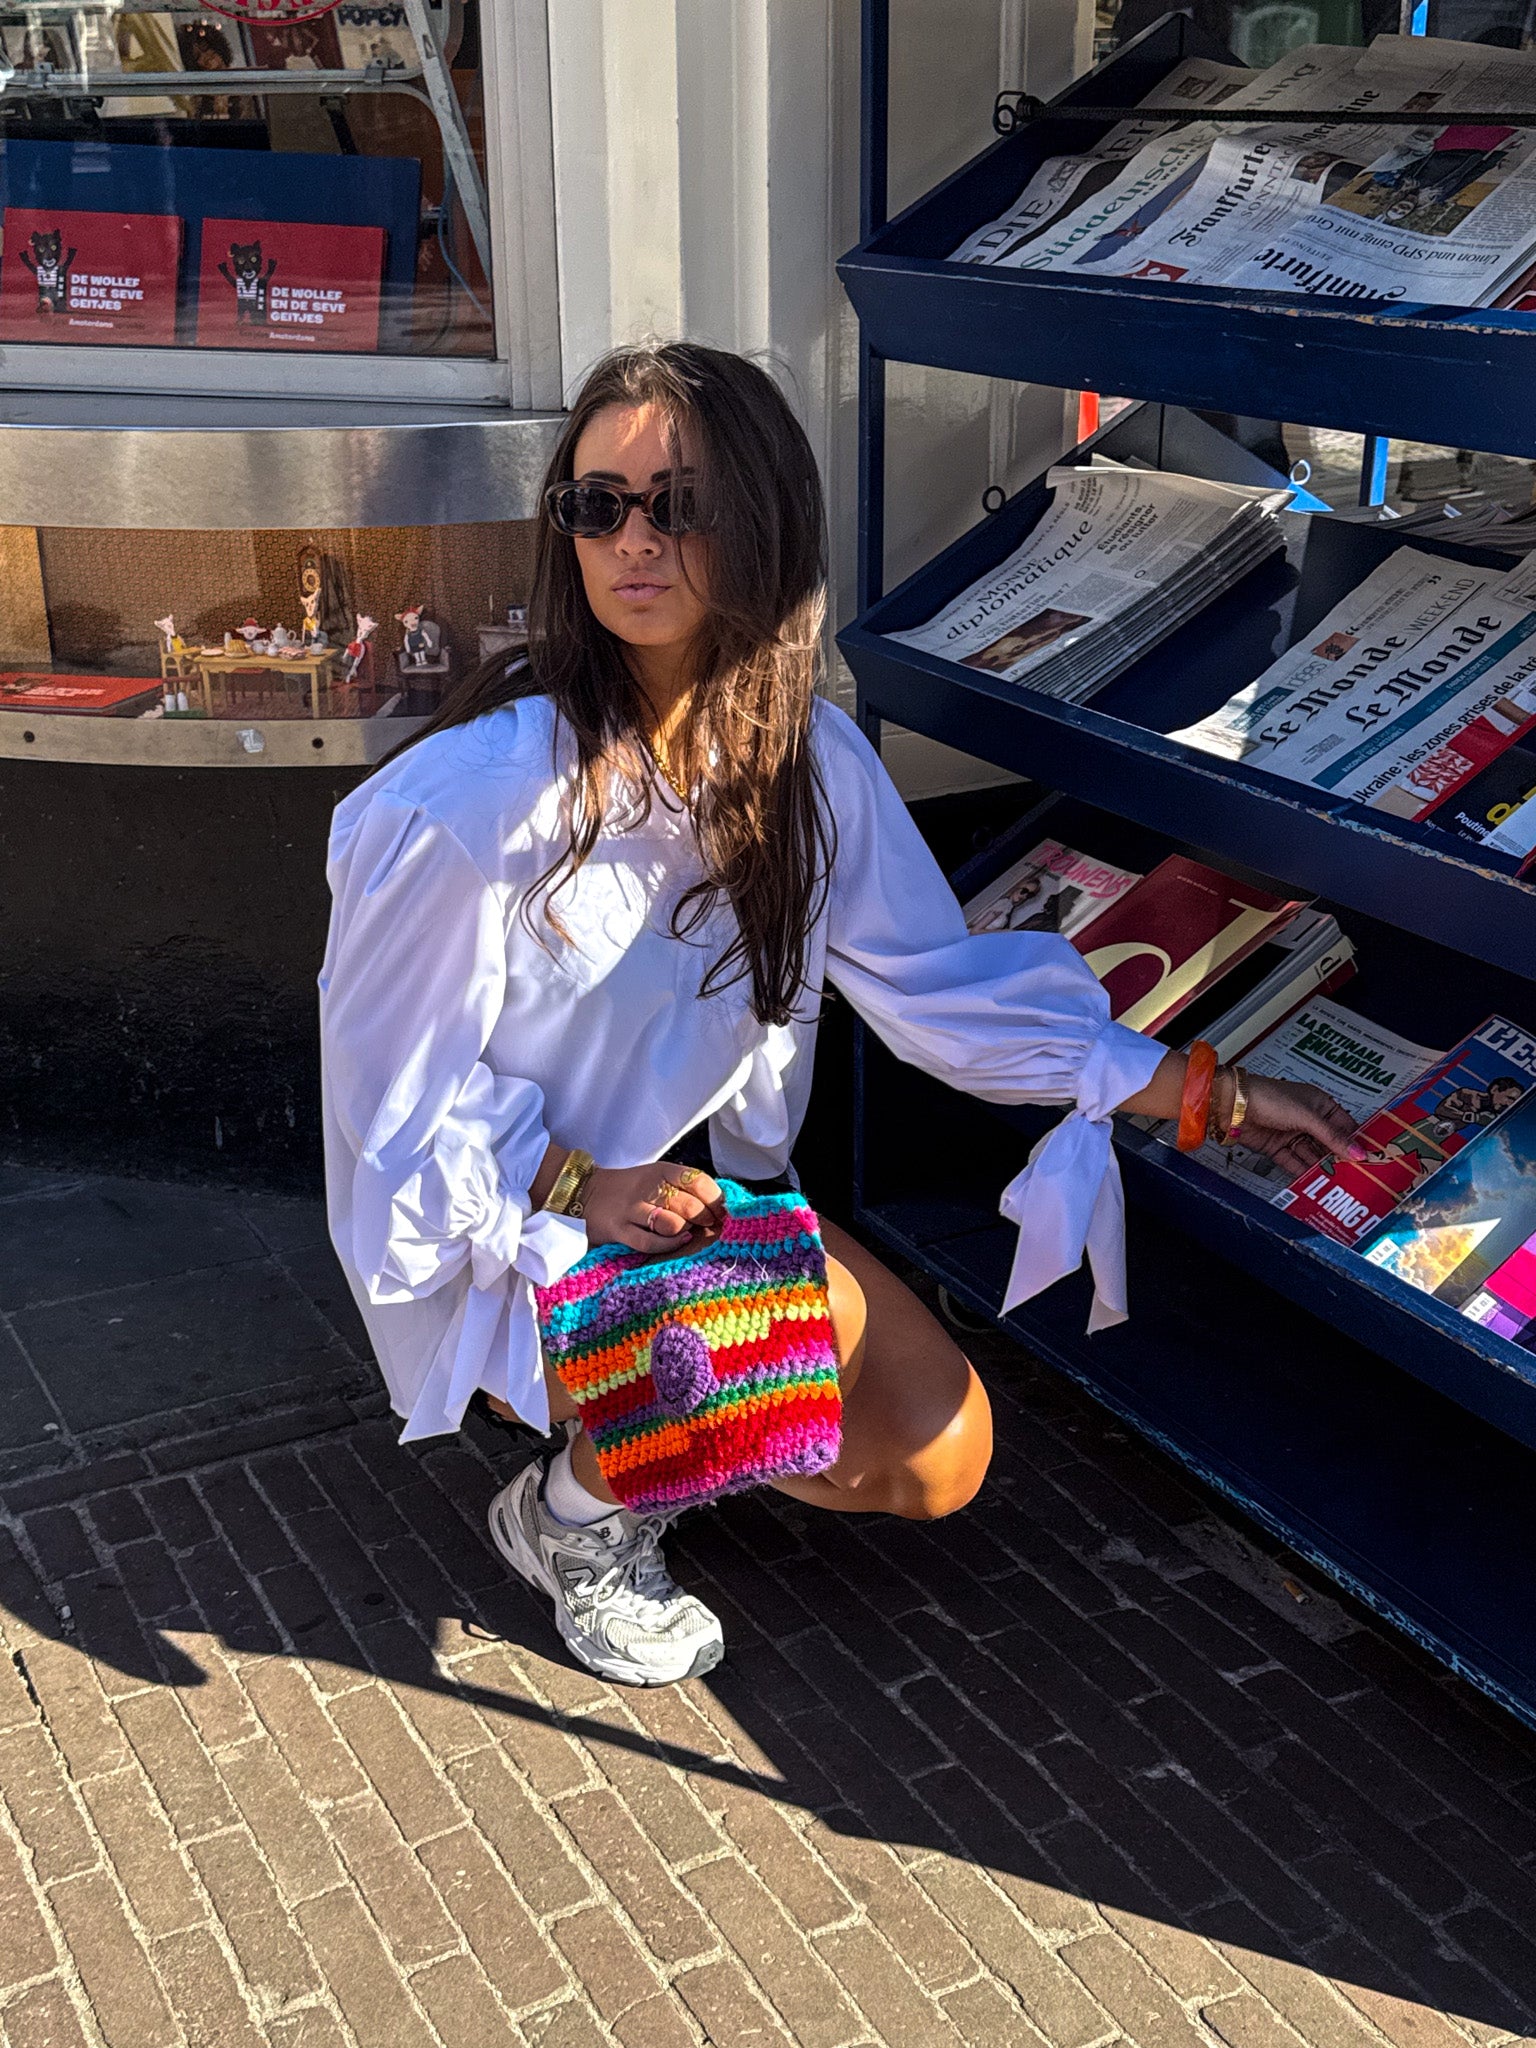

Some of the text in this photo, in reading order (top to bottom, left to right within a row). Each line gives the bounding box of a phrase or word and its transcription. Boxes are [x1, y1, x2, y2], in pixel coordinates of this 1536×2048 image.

[1020, 131, 1210, 271] Süddeutsche
[1168, 140, 1278, 248] Frankfurter
[976, 198, 1054, 250] DIE
[1335, 223, 1360, 240] mit
[1361, 231, 1394, 252] einig
[1392, 242, 1428, 260] SPD
[1428, 247, 1453, 262] und
[1455, 251, 1501, 266] Union
[70, 287, 144, 300] EN DE SEVE
[71, 274, 140, 288] DE WOLLEF
[271, 287, 343, 301] DE WOLLEF
[69, 298, 122, 311] GEITJES
[270, 300, 347, 313] EN DE SEVE
[270, 311, 324, 324] GEITJES
[947, 519, 1094, 641] diplomatique
[977, 557, 1040, 605] MONDE
[1346, 702, 1392, 733] Le
[1374, 615, 1502, 708] Monde
[1260, 720, 1300, 751] Le
[1286, 634, 1408, 723] Monde
[1399, 748, 1427, 764] les
[1422, 722, 1463, 751] zones
[1458, 694, 1499, 726] grises
[1493, 681, 1515, 696] de
[1505, 671, 1528, 683] la
[1296, 1012, 1315, 1034] LA
[1313, 1020, 1387, 1067] SETTIMANA
[1294, 1031, 1398, 1088] ENIGMISTICA
[1302, 1174, 1331, 1201] IL
[1317, 1185, 1370, 1230] RING
